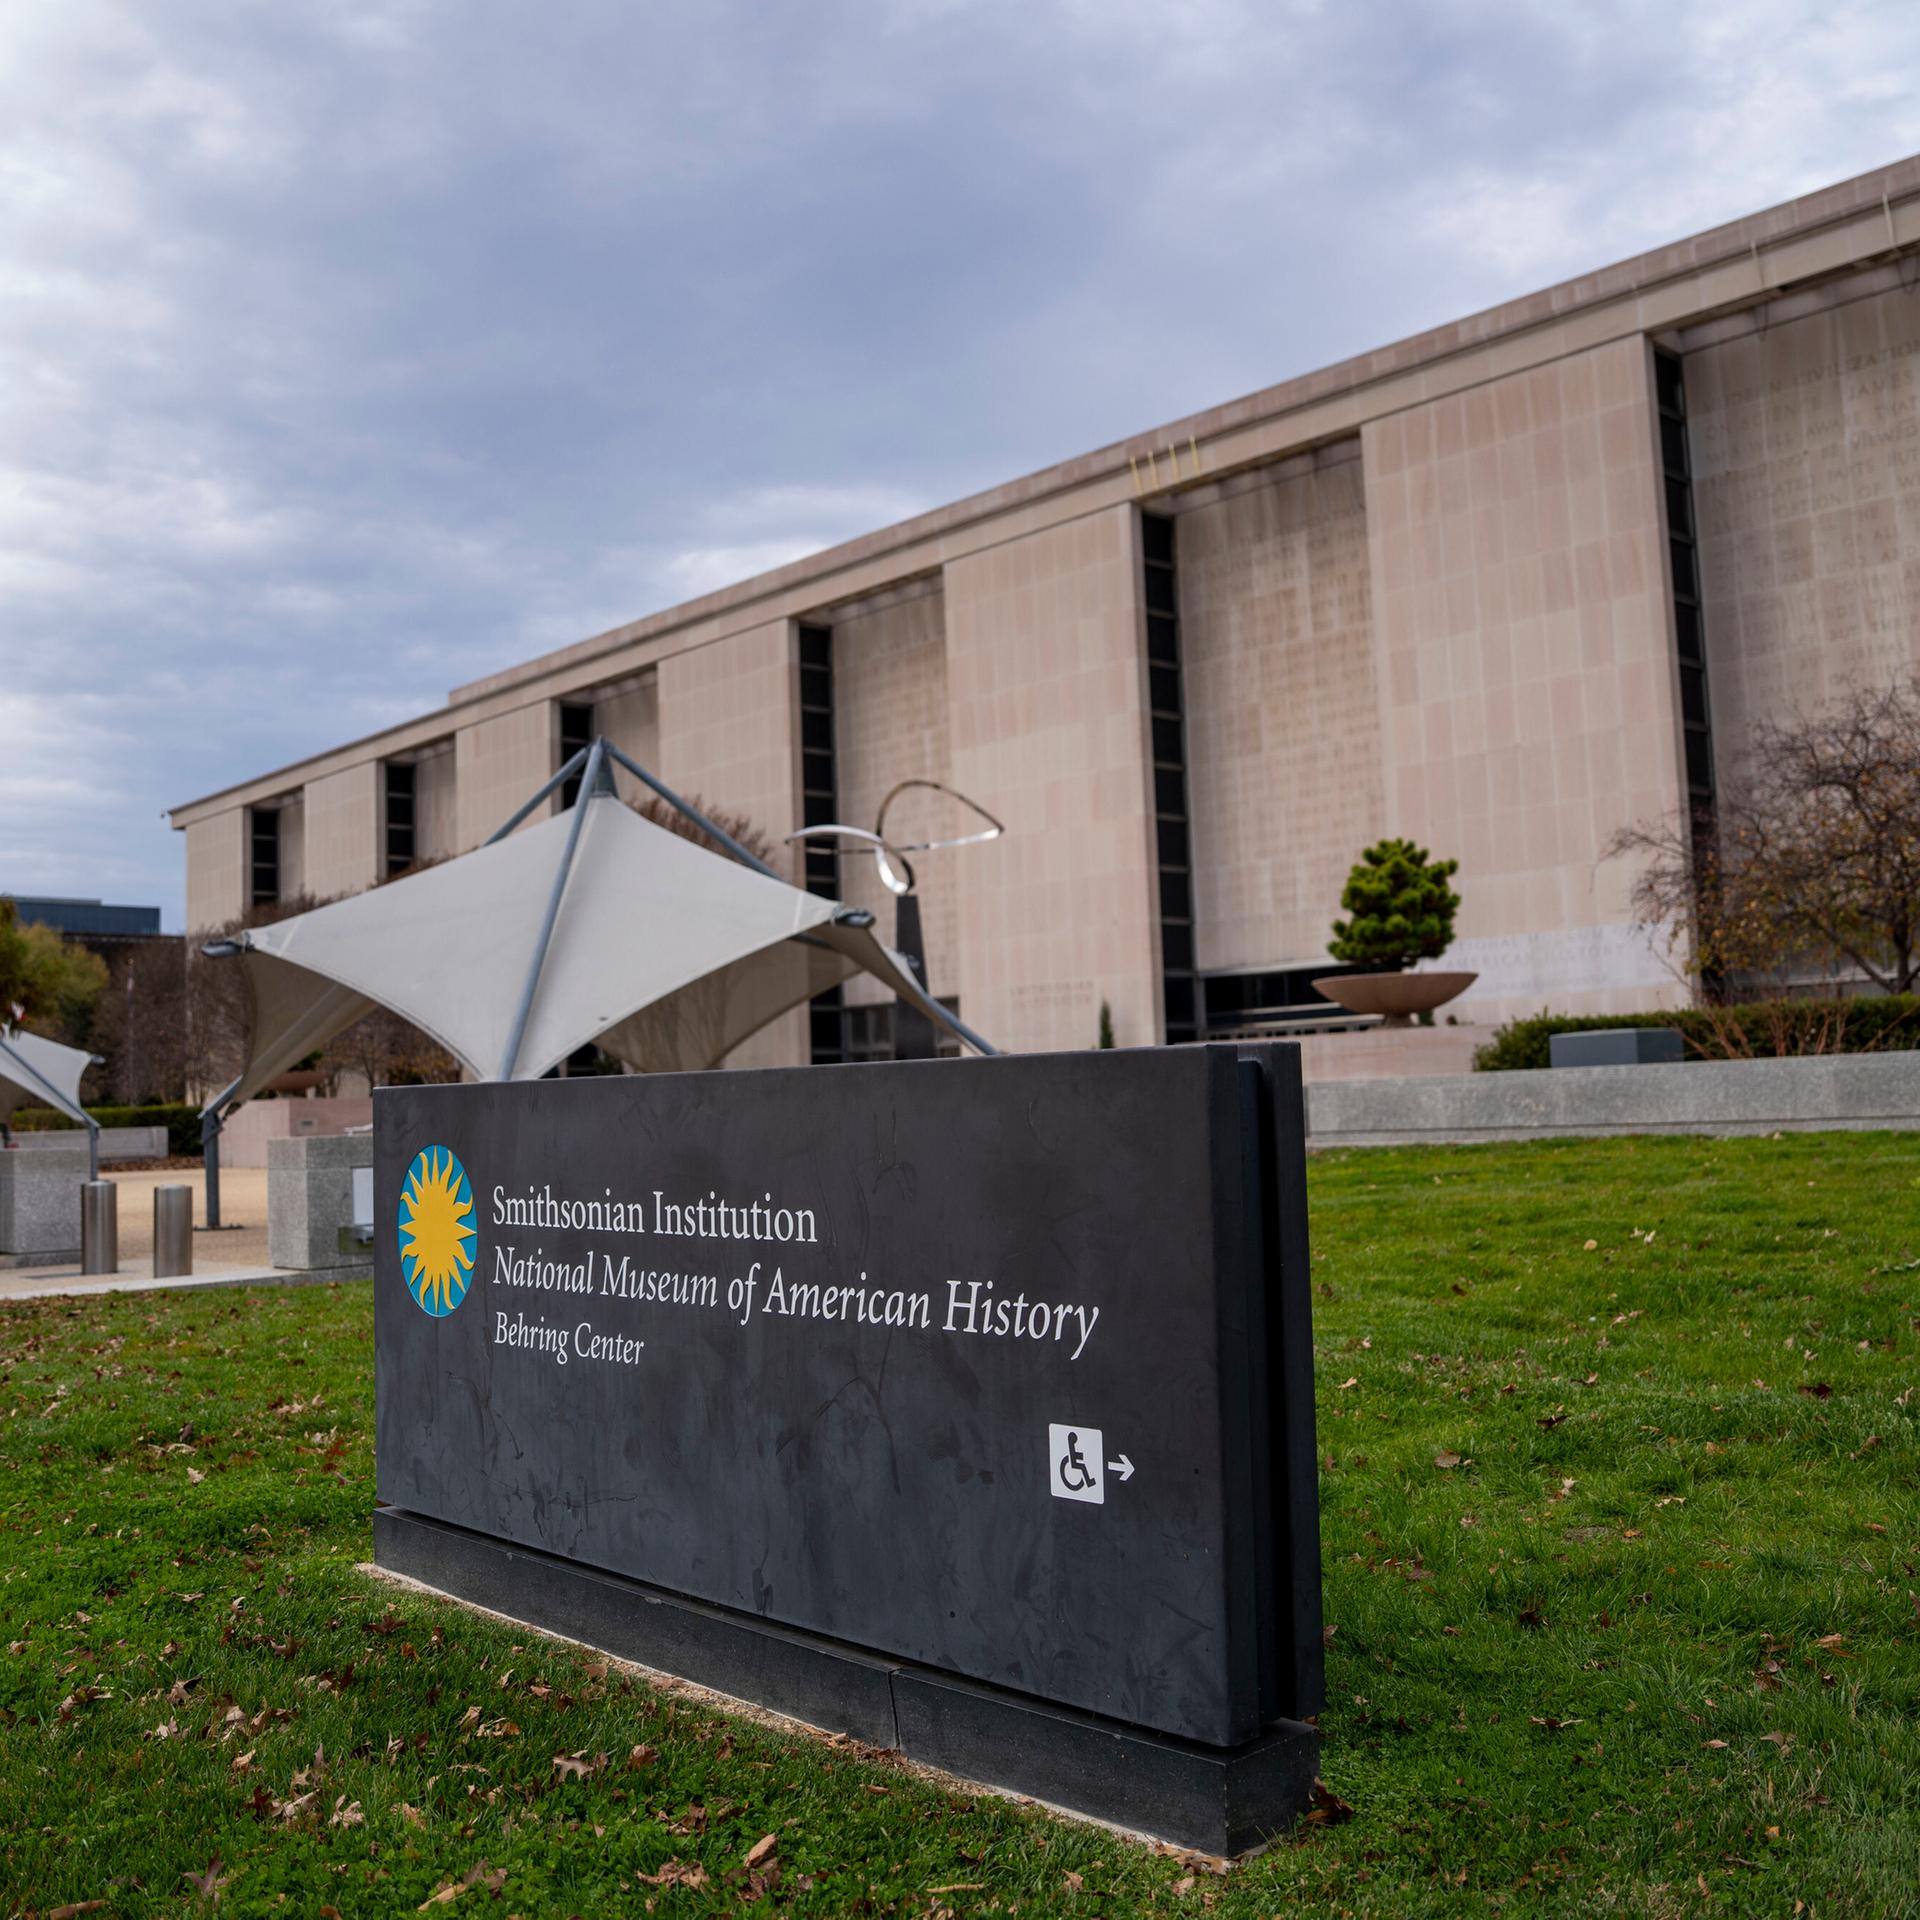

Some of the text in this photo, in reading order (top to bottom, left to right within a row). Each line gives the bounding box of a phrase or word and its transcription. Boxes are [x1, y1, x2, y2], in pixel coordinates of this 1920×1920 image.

[493, 1185, 817, 1242] Smithsonian Institution
[493, 1246, 1099, 1360] National Museum of American History
[494, 1311, 644, 1365] Behring Center
